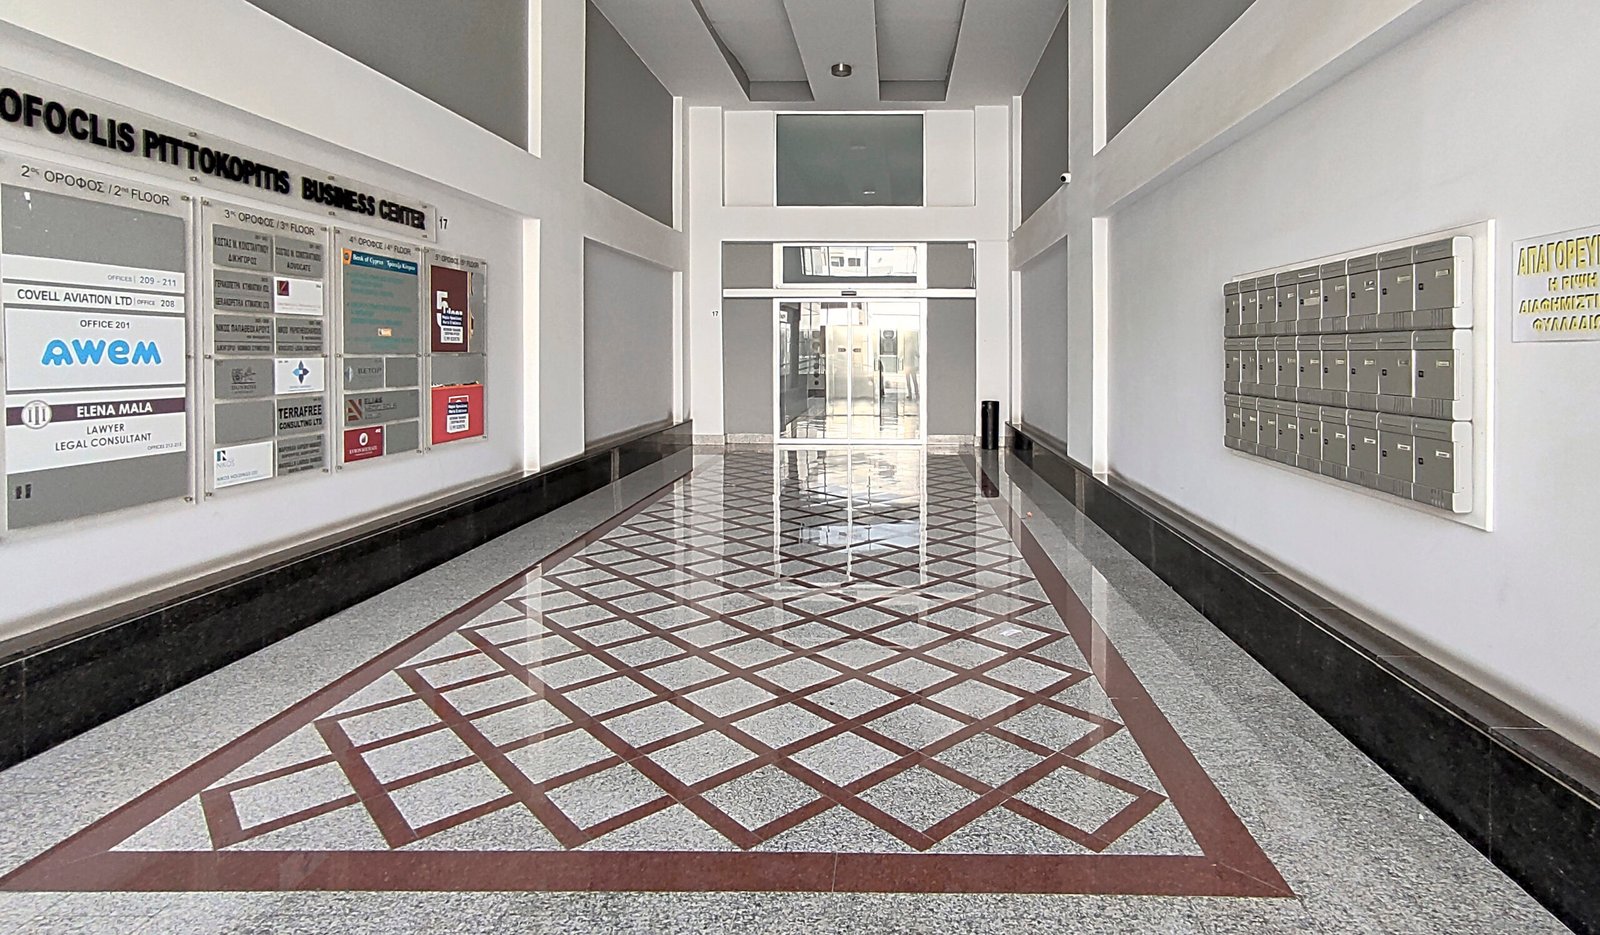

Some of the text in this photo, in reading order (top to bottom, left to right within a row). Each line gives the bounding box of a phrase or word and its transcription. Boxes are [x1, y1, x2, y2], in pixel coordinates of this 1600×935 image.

[142, 128, 290, 195] PITTOKOPITIS
[301, 176, 376, 216] BUSINESS
[378, 199, 426, 230] CENTER
[44, 170, 104, 193] ΟΡΟΦΟΣ
[131, 188, 170, 206] FLOOR
[238, 212, 275, 228] ΟΡΟΦΟΣ
[290, 222, 315, 236] FLOOR
[439, 215, 449, 231] 17
[393, 245, 412, 255] FLOOR
[1517, 234, 1600, 276] ΑΠΑΓΟΡΕΥ
[287, 261, 312, 272] ADVOCATE
[140, 276, 155, 285] 209
[163, 278, 177, 287] 211
[1548, 272, 1598, 291] Η ΡΙΨΗ
[17, 289, 60, 302] COVELL
[63, 292, 112, 305] AVIATION
[115, 295, 133, 306] LTD
[161, 300, 175, 308] 208
[80, 319, 131, 329] OFFICE 201
[76, 401, 153, 418] ELENA MALA
[278, 404, 322, 419] TERRAFREE
[87, 423, 125, 436] LAWYER
[279, 419, 312, 430] CONSULTING
[55, 432, 152, 452] LEGAL CONSULTANT
